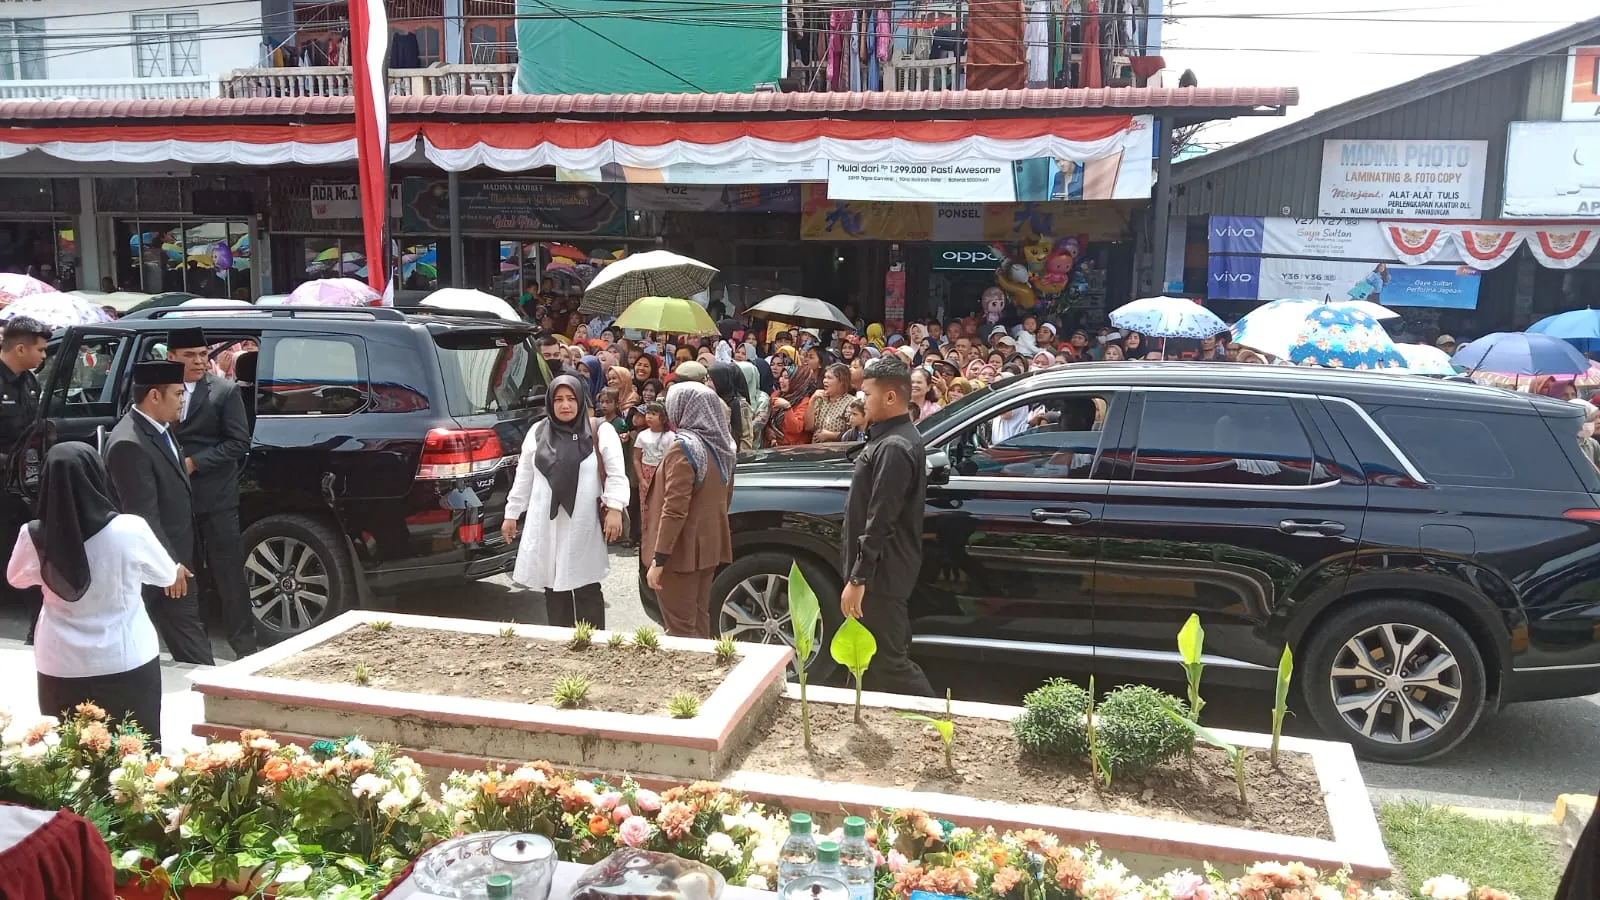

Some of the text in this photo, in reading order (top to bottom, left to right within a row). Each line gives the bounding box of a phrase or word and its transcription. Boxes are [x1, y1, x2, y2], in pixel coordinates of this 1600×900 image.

[1340, 143, 1470, 168] MADINA PHOTO
[837, 164, 860, 173] Mulai
[861, 164, 879, 173] dari
[890, 165, 927, 174] 1.299.000
[931, 165, 953, 174] Pasti
[955, 166, 1001, 174] Awesome
[1345, 171, 1463, 183] LAMINATING & FOTO COPY
[482, 183, 545, 192] MADINA MARKET
[312, 185, 358, 200] ADA No.1
[1437, 191, 1460, 199] TULIS
[1388, 200, 1434, 208] PERLENGKAPAN
[938, 209, 981, 218] PONSEL
[1215, 225, 1256, 237] vivo
[1322, 228, 1352, 238] Sultan
[1213, 270, 1252, 282] vivo
[1305, 273, 1322, 281] Y36
[1406, 286, 1436, 294] Performa
[476, 478, 495, 487] VXR
